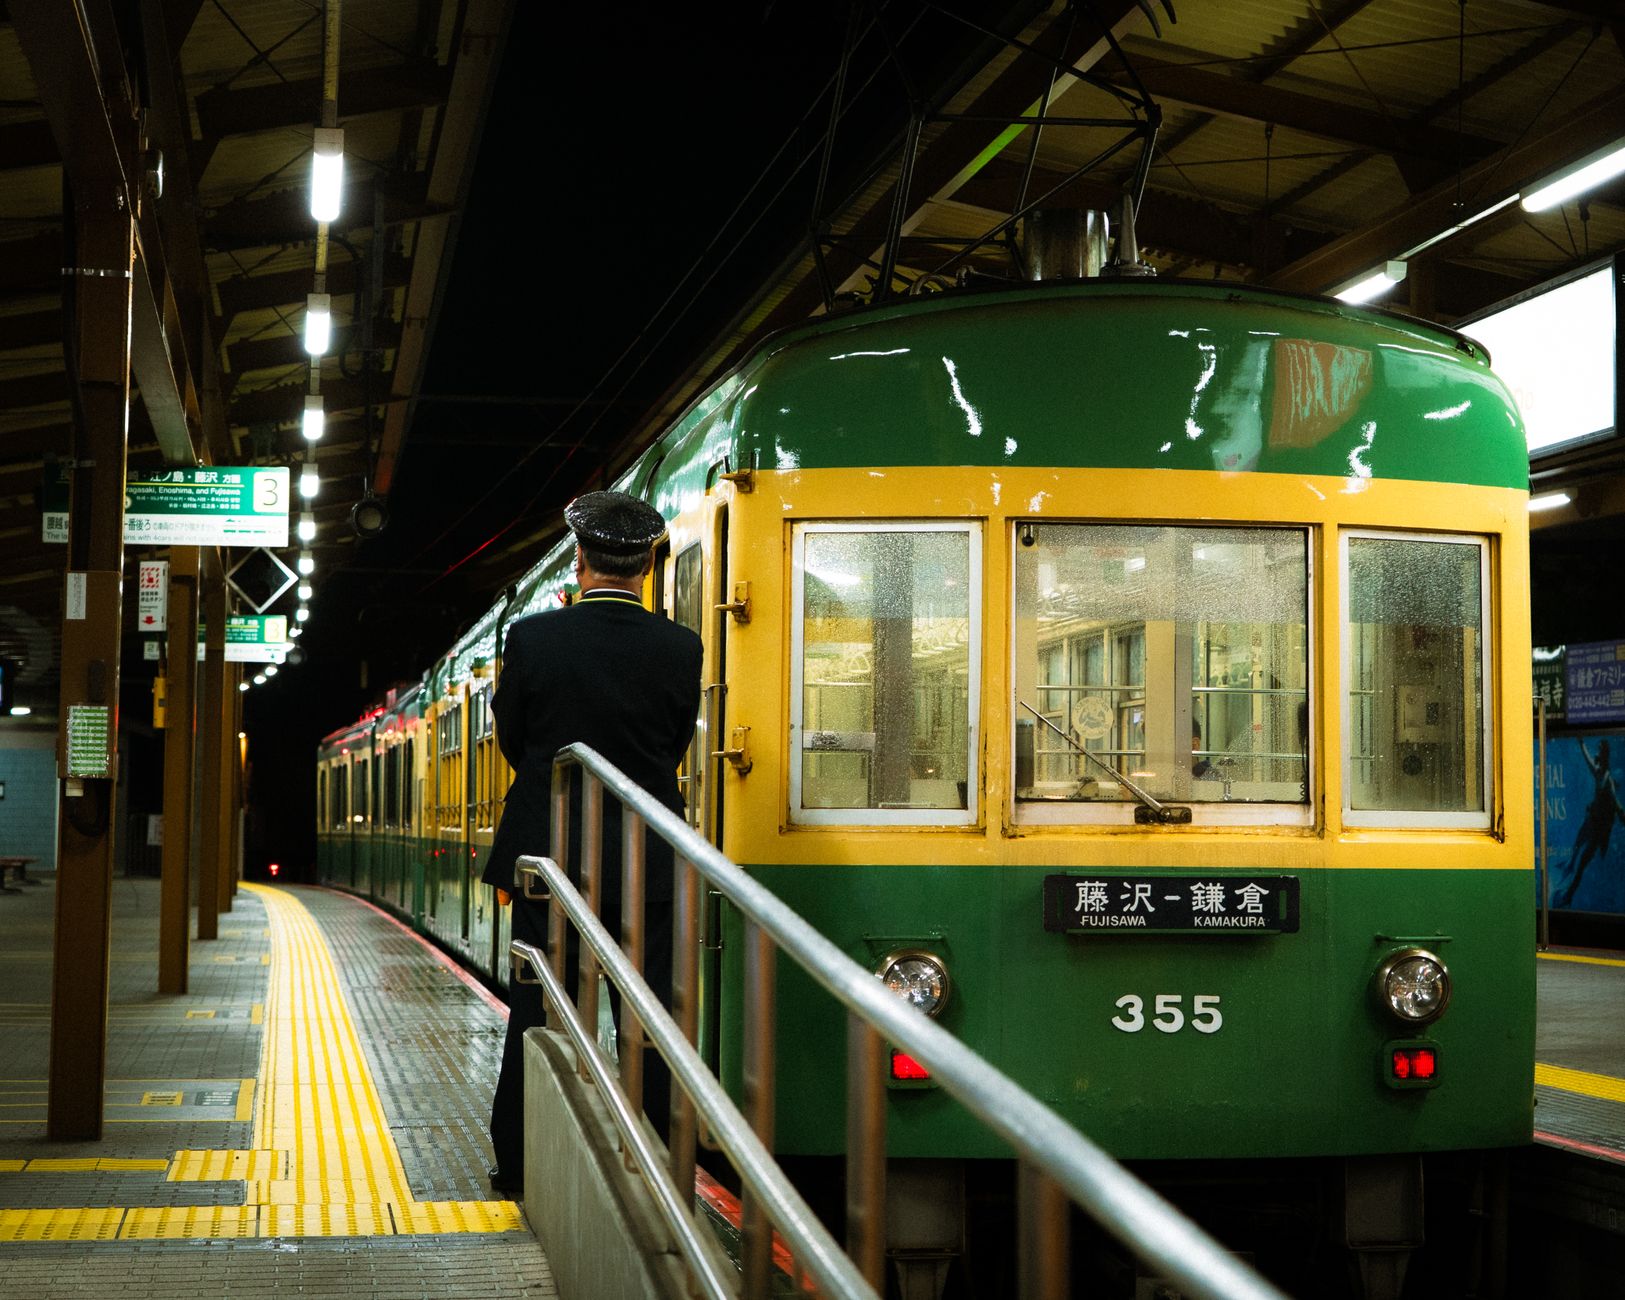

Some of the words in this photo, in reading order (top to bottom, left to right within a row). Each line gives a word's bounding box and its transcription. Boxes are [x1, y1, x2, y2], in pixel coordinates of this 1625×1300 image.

[125, 487, 156, 496] ragasaki,
[158, 487, 194, 496] Enoshima,
[196, 487, 209, 495] and
[210, 487, 241, 497] Fujisawa
[262, 478, 279, 506] 3
[1081, 915, 1147, 927] FUJISAWA
[1194, 916, 1266, 927] KAMAKURA
[1111, 994, 1223, 1034] 355
